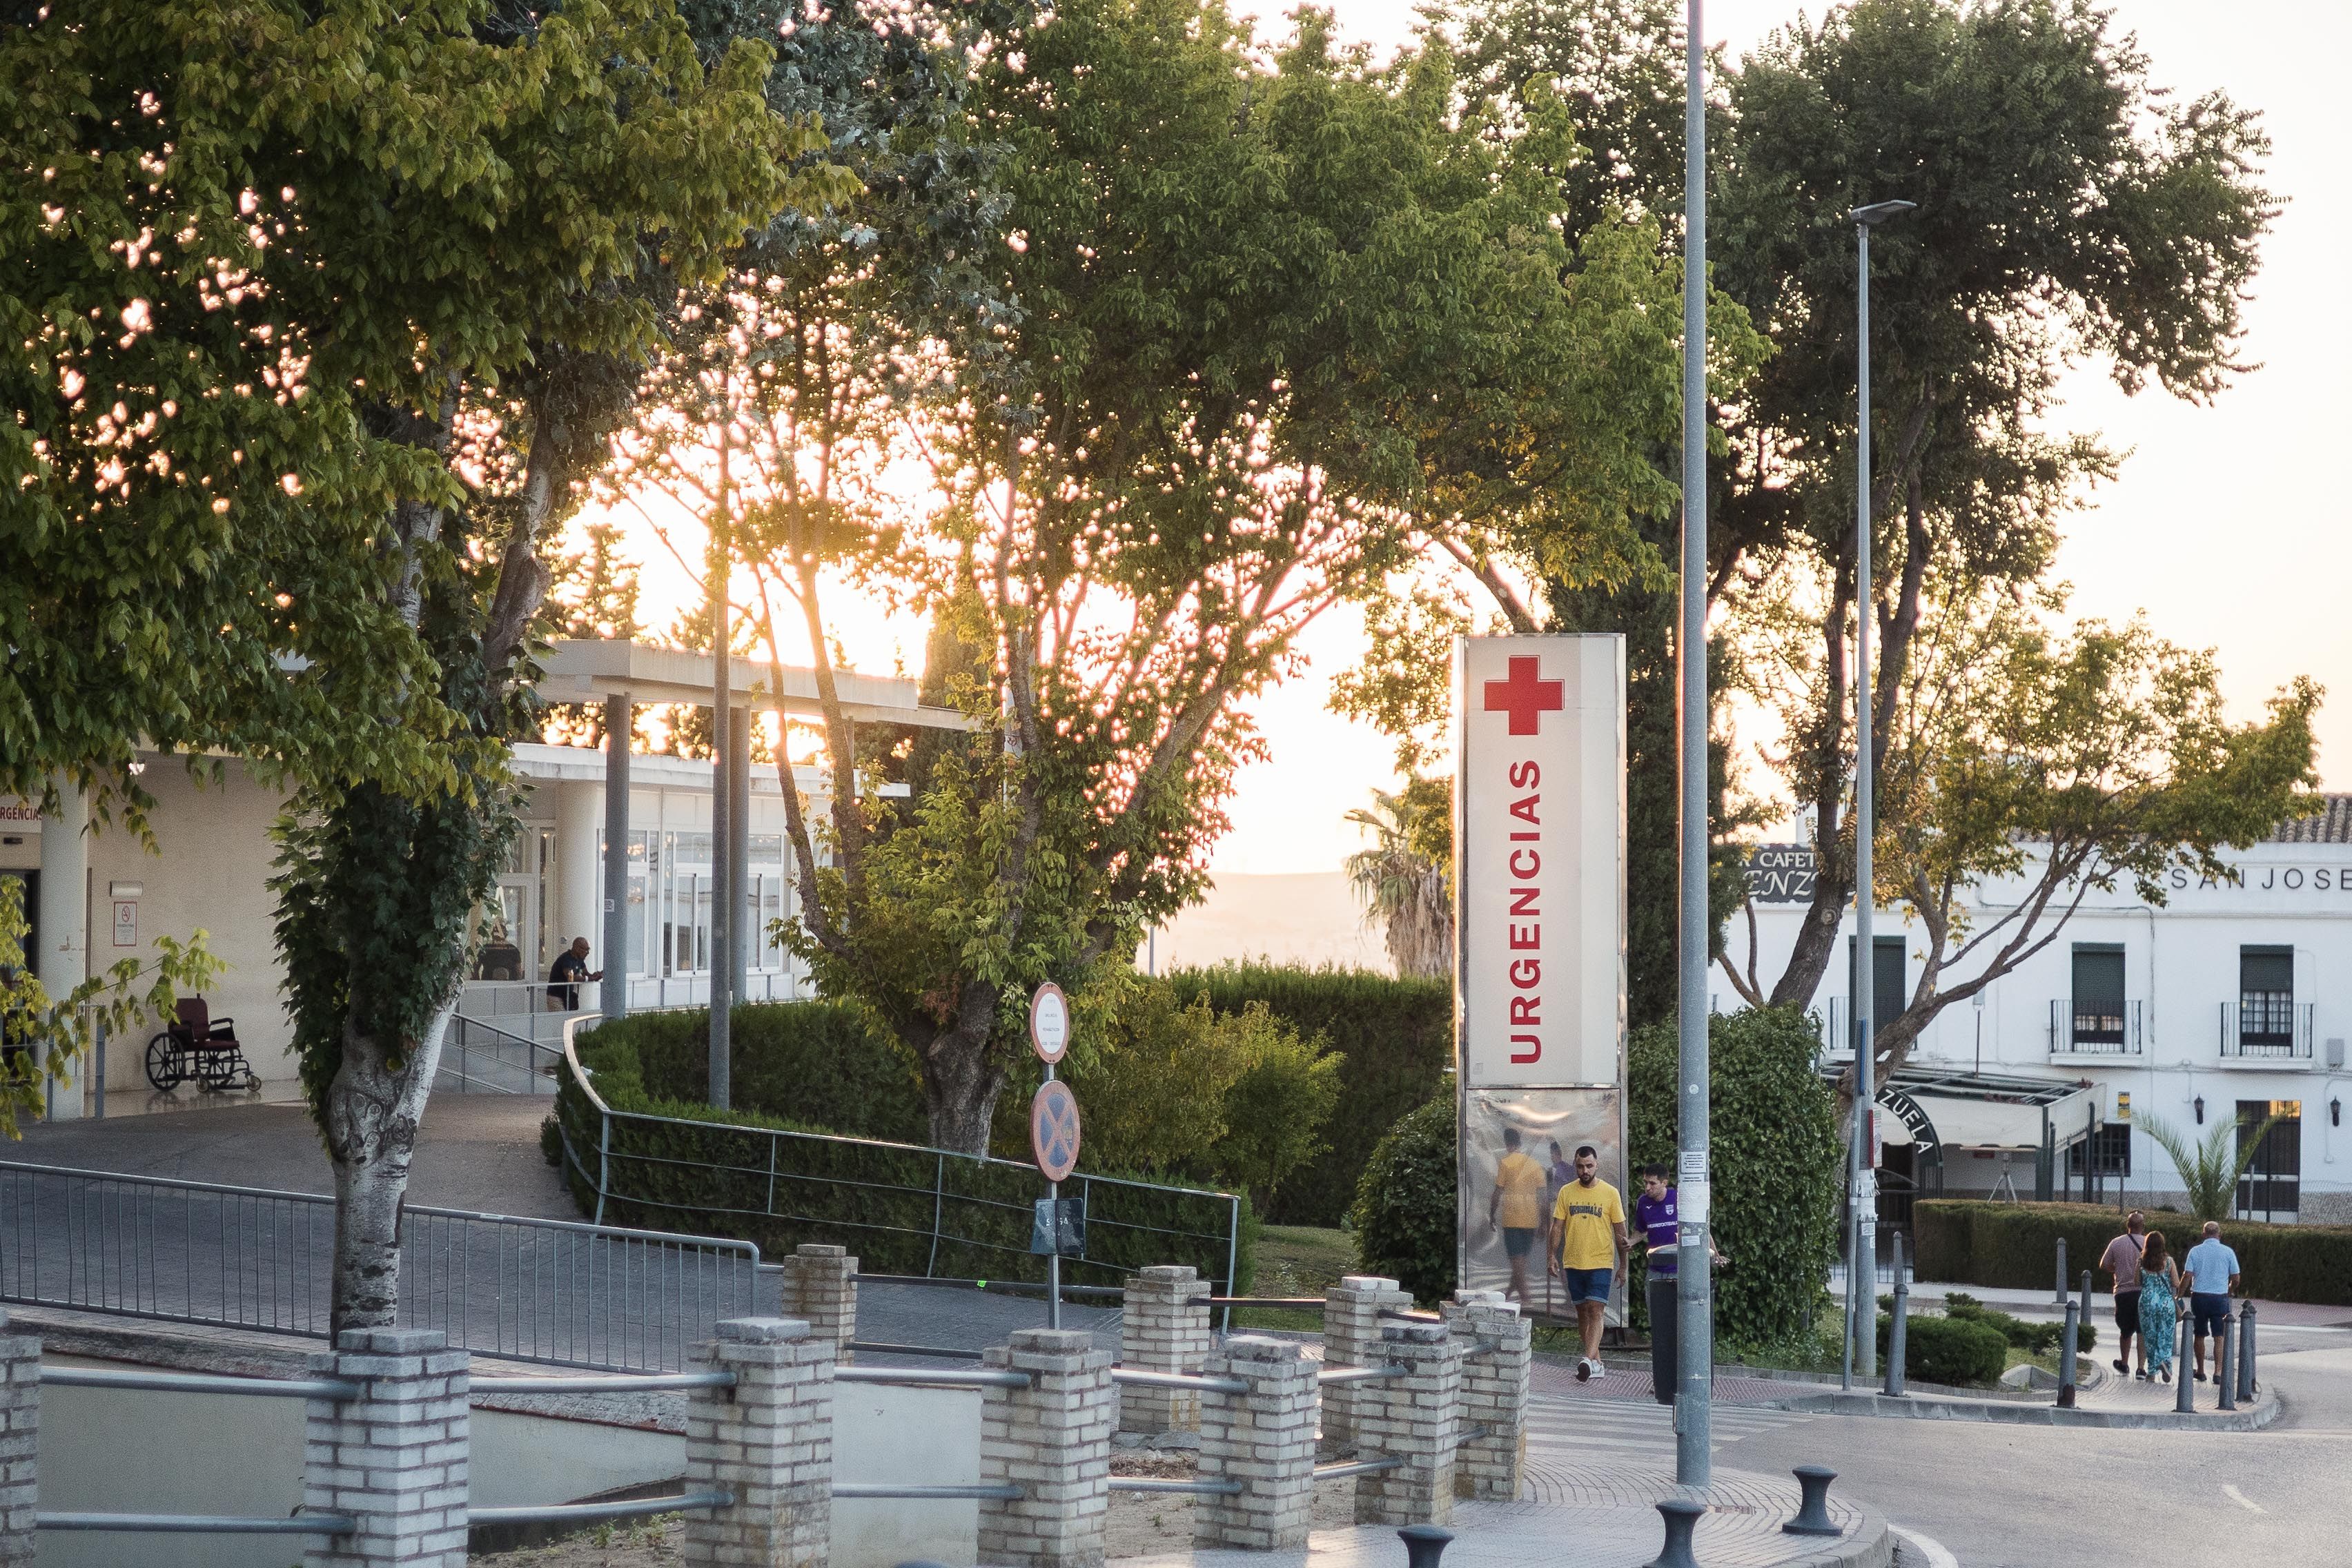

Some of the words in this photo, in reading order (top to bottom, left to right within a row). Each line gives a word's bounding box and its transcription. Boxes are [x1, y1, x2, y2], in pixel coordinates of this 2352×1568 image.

[0, 806, 43, 821] RGENCIA
[1759, 852, 1815, 868] CAFET
[1743, 870, 1819, 896] ENZ
[2171, 868, 2245, 890] SAN
[2262, 868, 2352, 890] JOSE
[1509, 760, 1541, 1064] URGENCIAS
[1876, 1088, 1934, 1155] ZUELA
